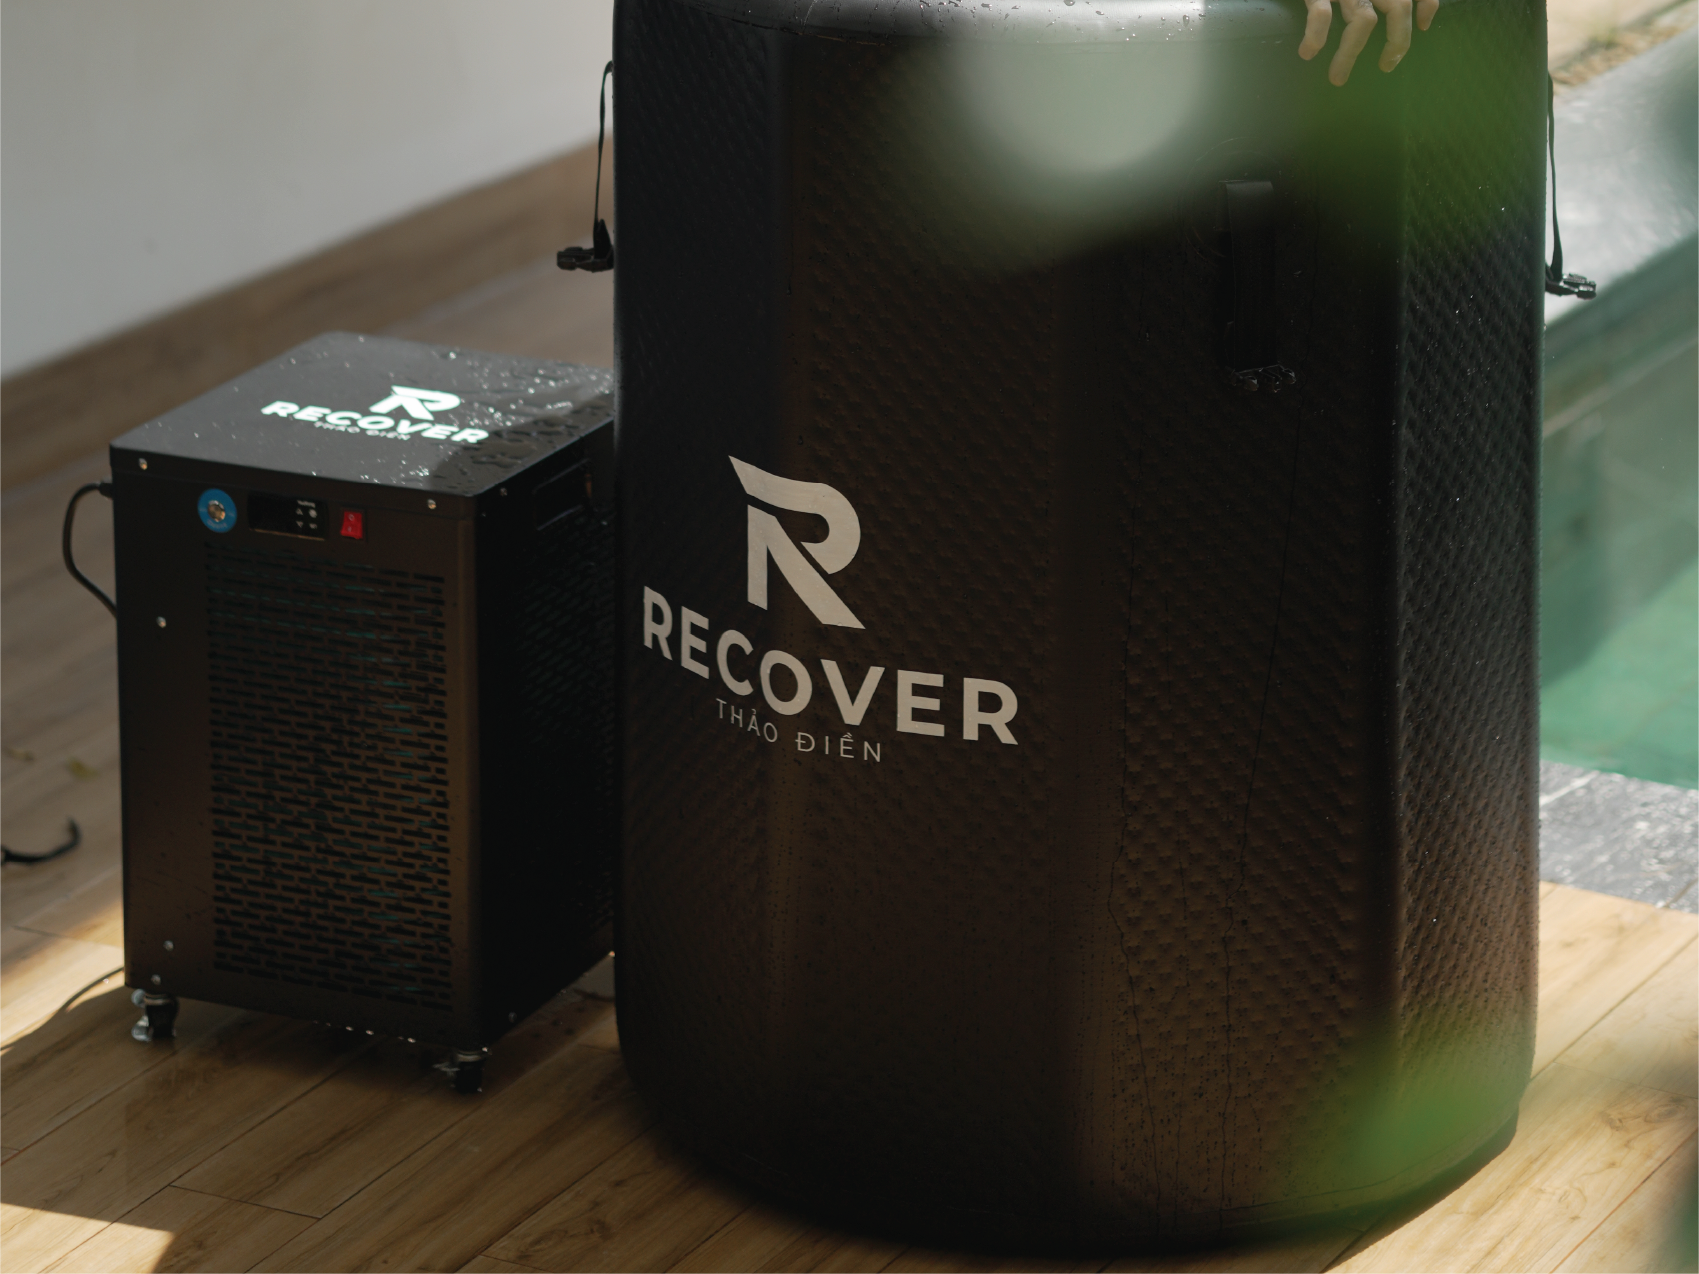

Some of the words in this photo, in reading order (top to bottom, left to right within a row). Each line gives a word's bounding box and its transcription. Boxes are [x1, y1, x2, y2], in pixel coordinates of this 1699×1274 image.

[261, 401, 489, 443] RECOVER
[728, 455, 866, 630] R
[643, 585, 1019, 746] RECOVER
[716, 698, 778, 743] THẢO
[795, 731, 881, 763] ĐIỀN
